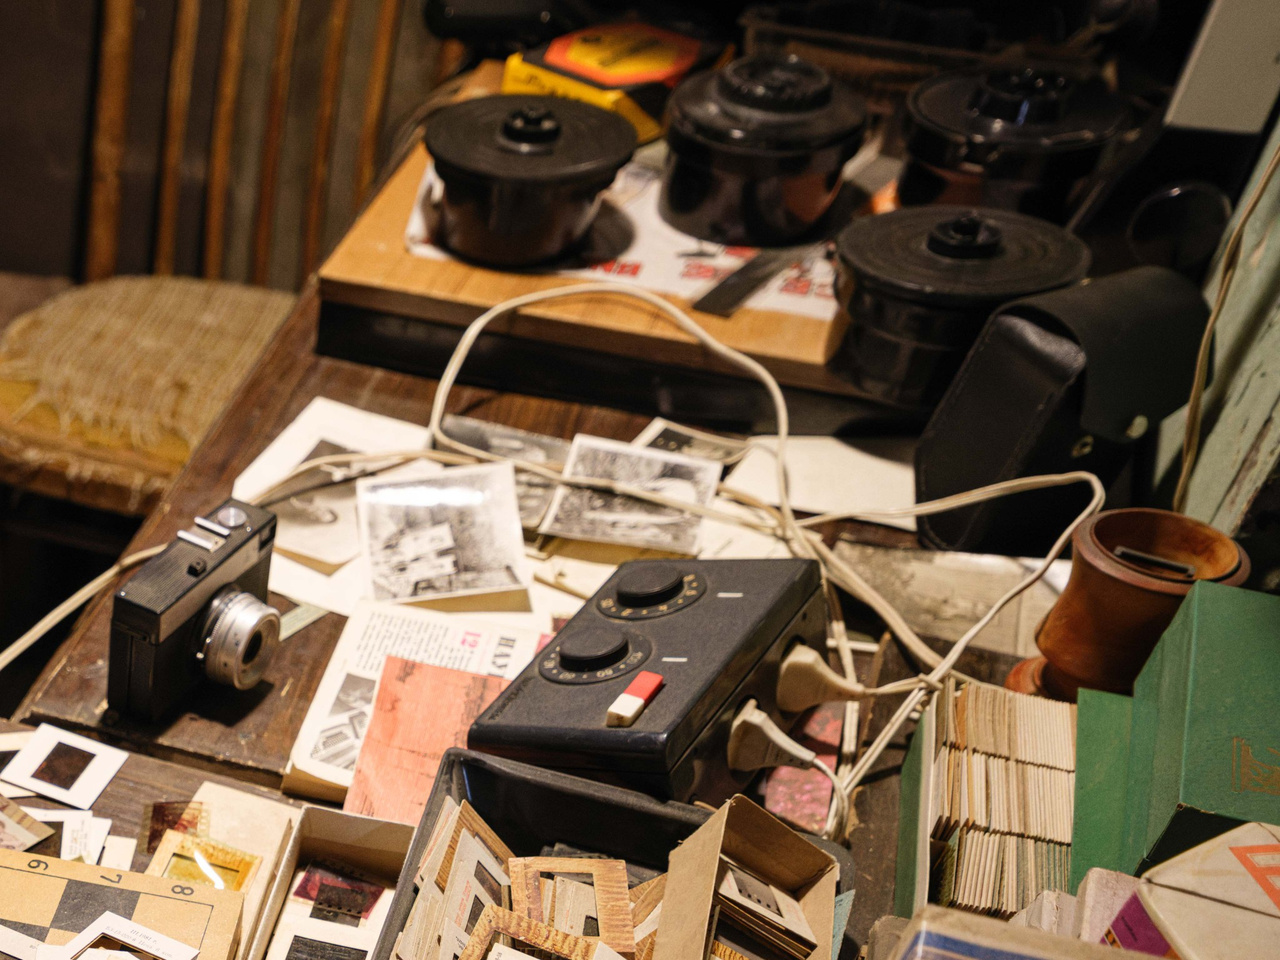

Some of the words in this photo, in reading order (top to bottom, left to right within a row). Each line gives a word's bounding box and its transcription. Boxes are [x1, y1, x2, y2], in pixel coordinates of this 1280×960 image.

[460, 629, 481, 649] 12
[27, 858, 49, 873] 6
[99, 872, 123, 885] 7
[170, 883, 195, 897] 8
